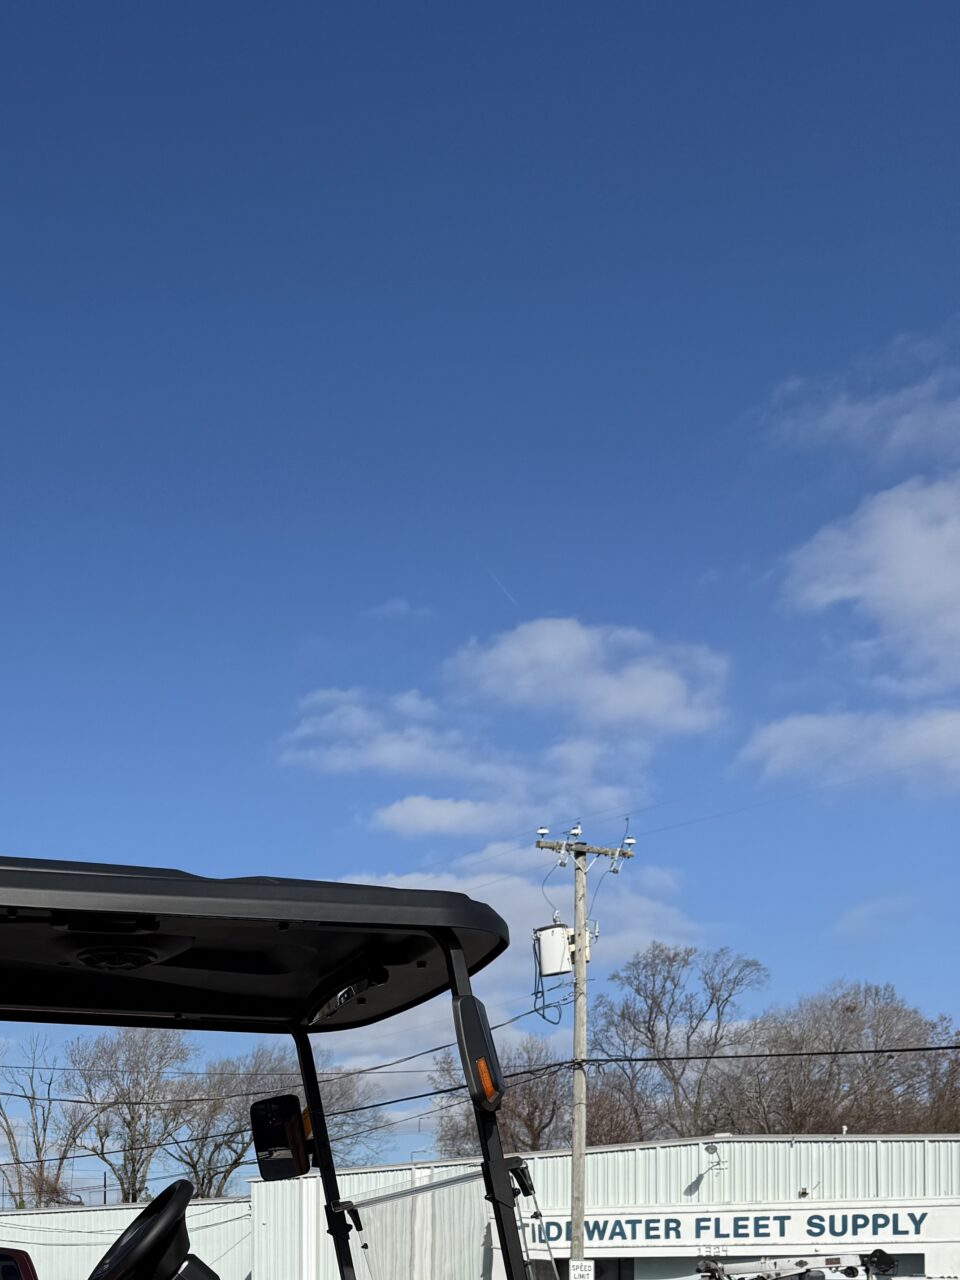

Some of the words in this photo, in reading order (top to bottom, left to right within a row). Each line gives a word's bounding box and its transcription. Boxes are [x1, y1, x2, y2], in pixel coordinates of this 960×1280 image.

[695, 1216, 791, 1239] FLEET
[806, 1212, 928, 1237] SUPPLY
[571, 1264, 592, 1272] SPEED
